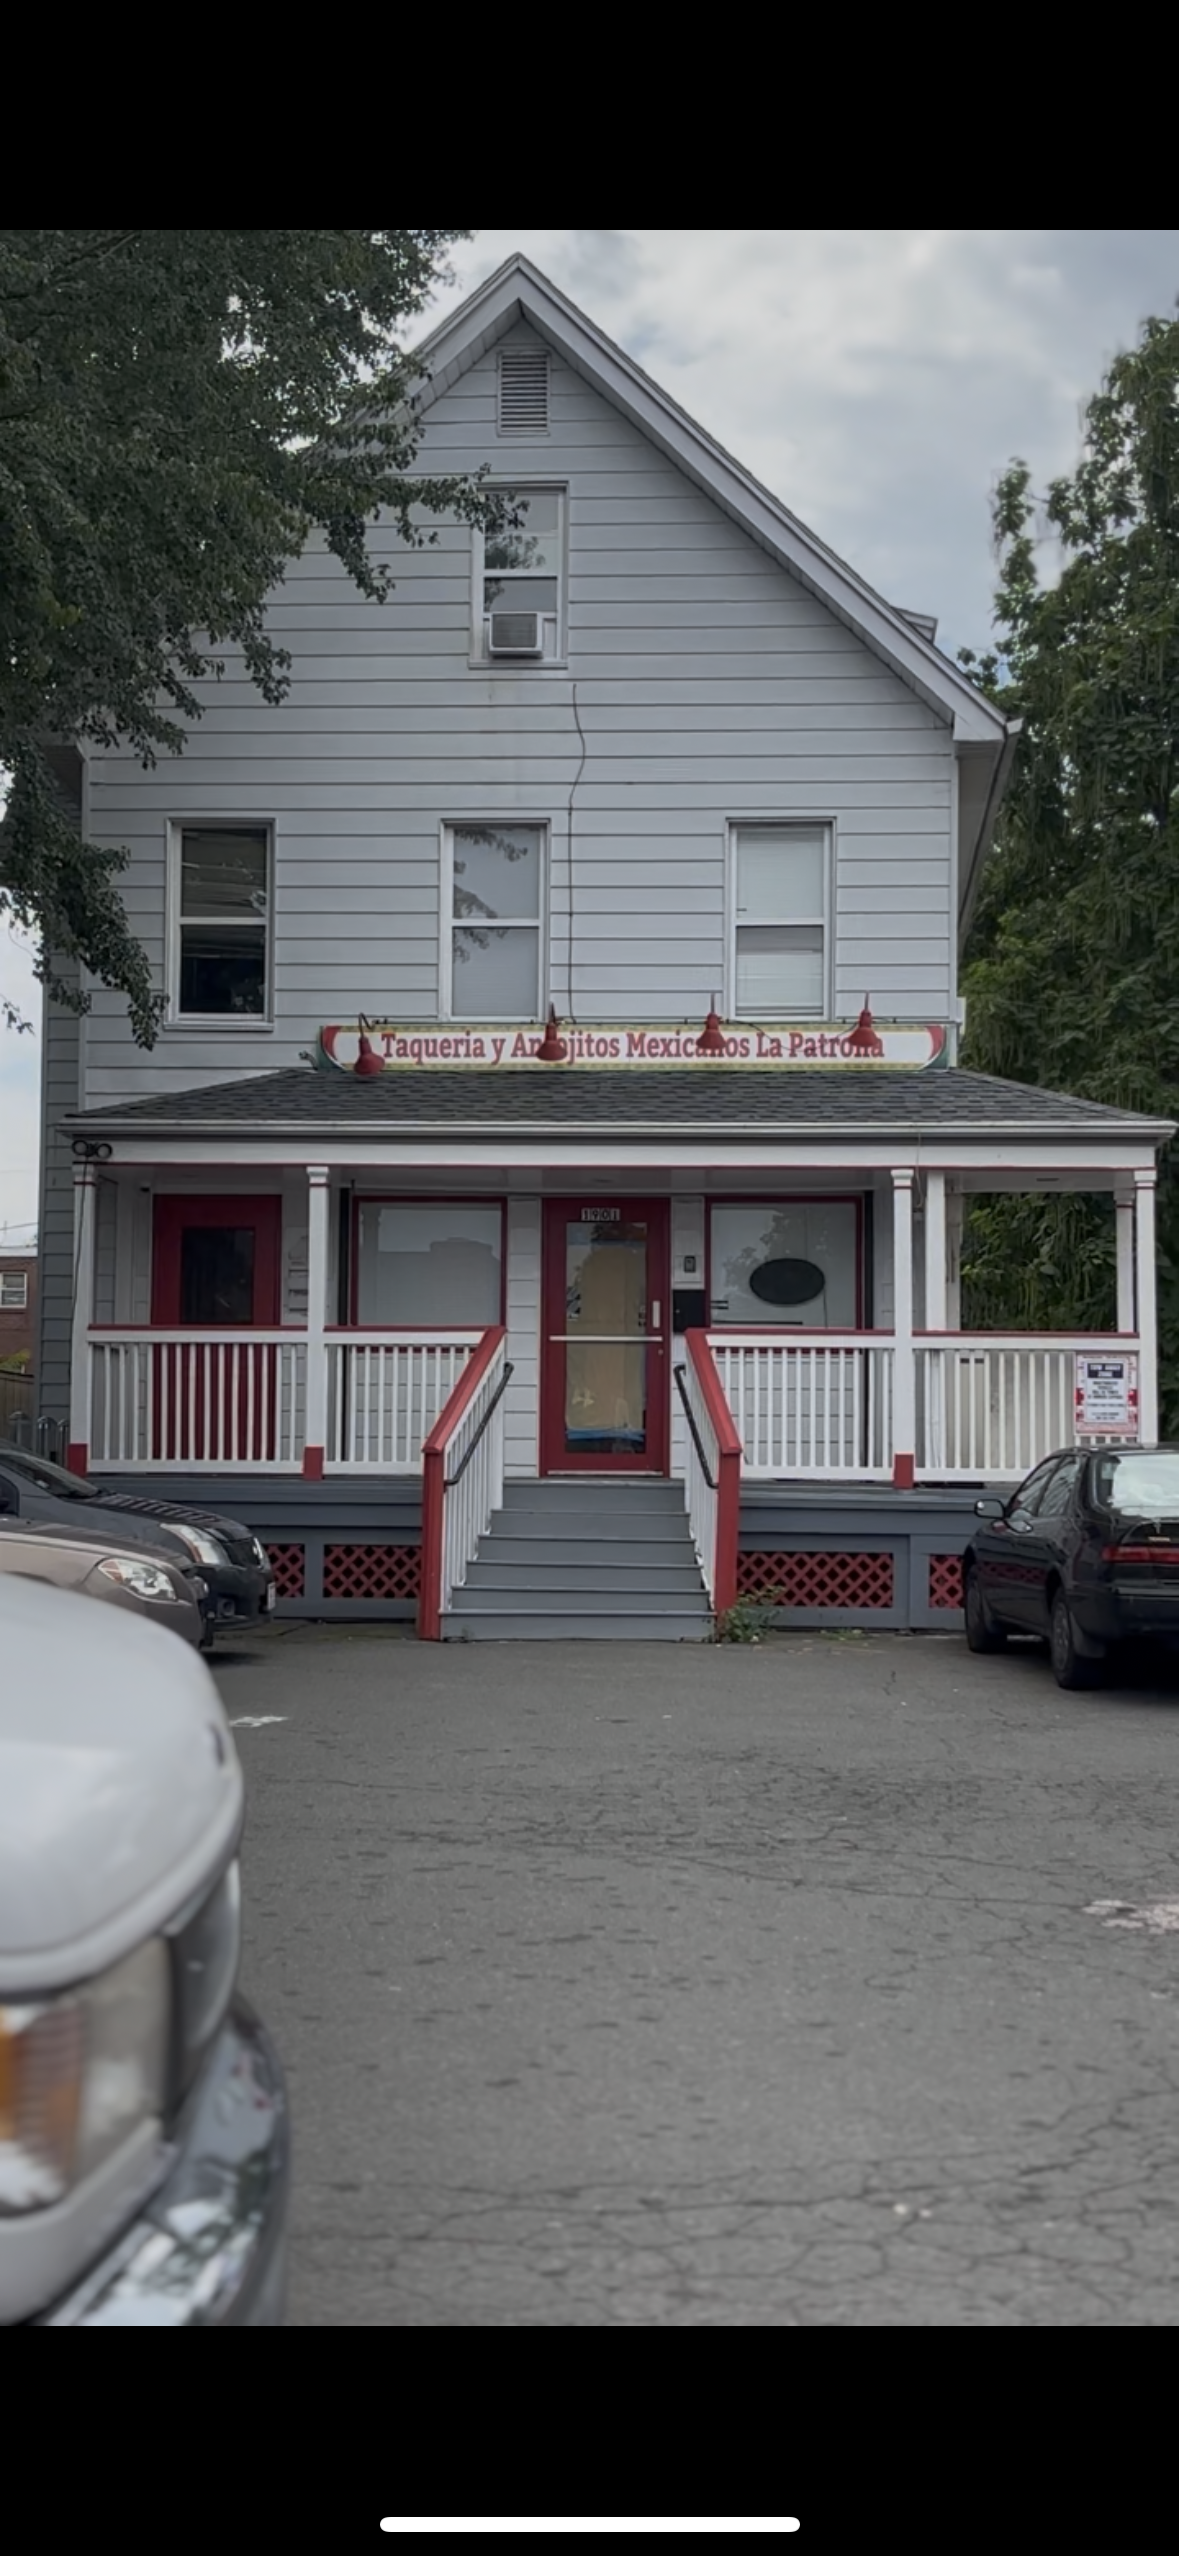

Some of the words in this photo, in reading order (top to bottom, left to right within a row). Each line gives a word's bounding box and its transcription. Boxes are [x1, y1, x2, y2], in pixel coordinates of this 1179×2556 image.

[381, 1030, 486, 1065] Taqueria
[491, 1036, 506, 1065] y
[510, 1029, 620, 1066] Anjitos
[756, 1032, 784, 1058] La
